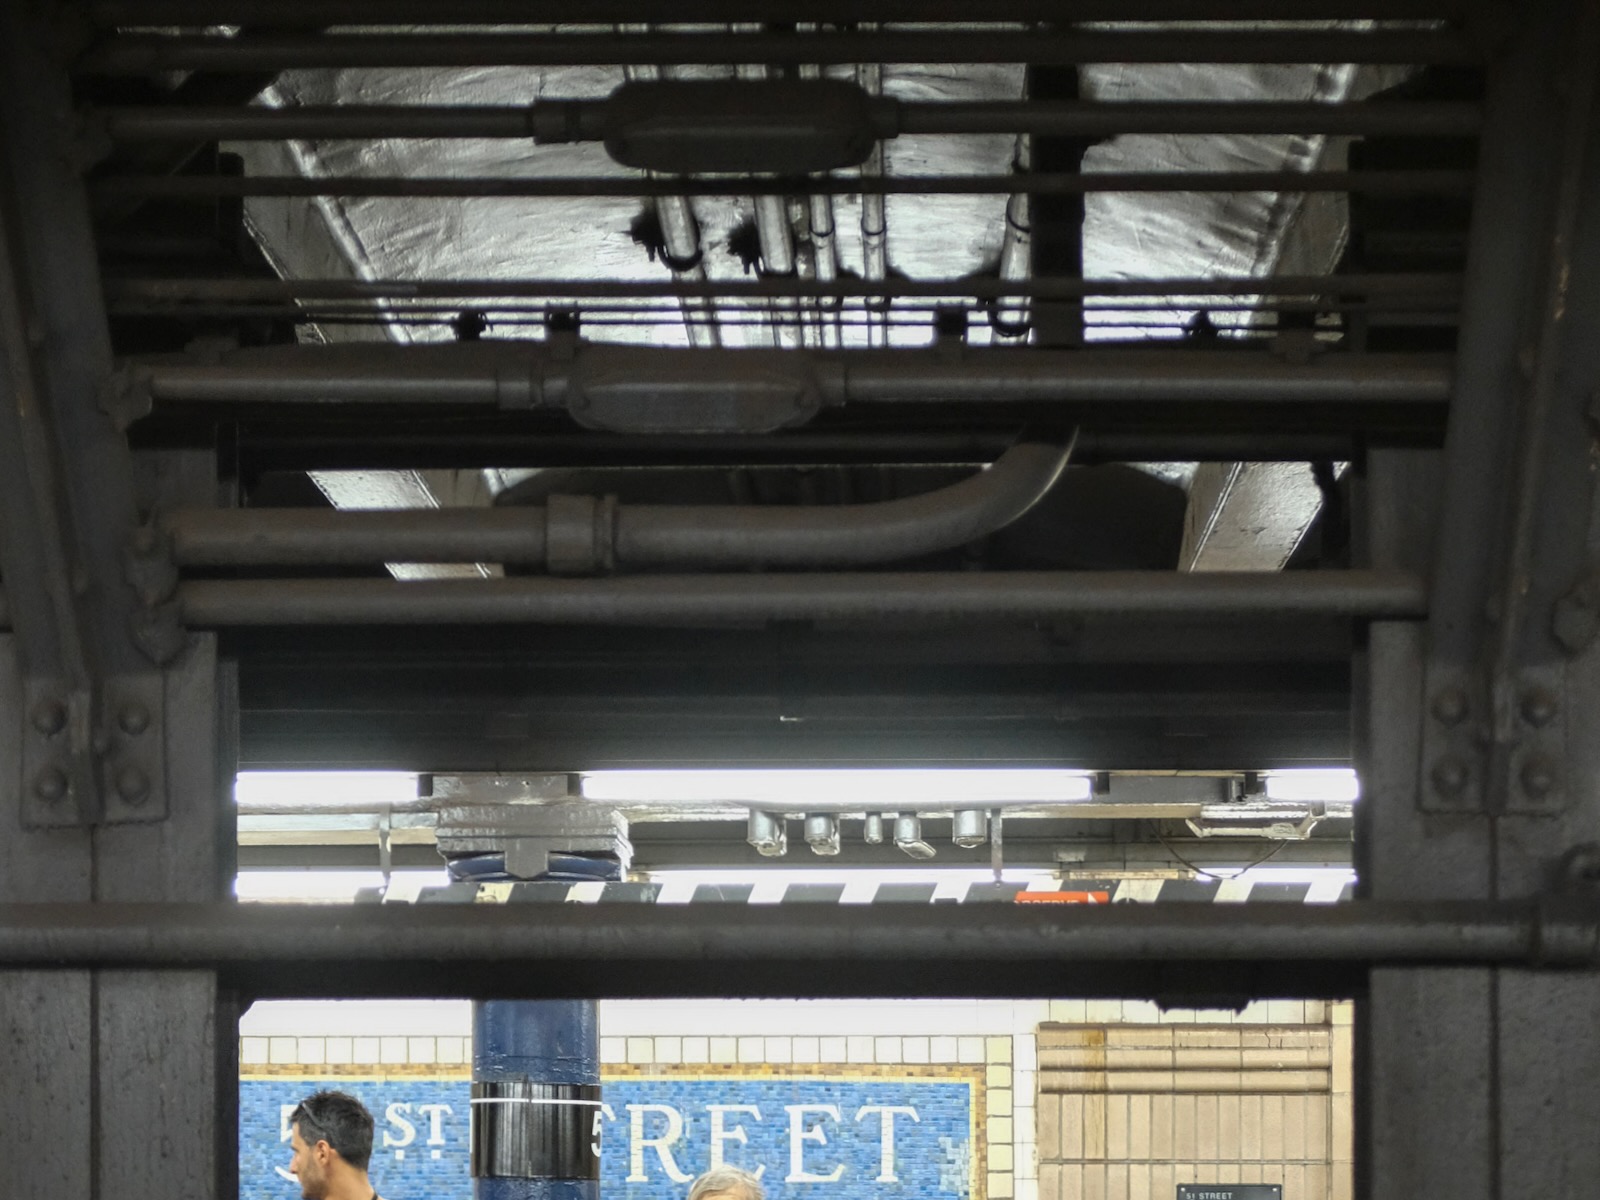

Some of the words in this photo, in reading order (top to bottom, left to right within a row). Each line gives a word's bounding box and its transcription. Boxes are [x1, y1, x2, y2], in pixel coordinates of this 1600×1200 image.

[601, 1104, 921, 1183] REET
[1186, 1192, 1195, 1200] 51
[1199, 1192, 1232, 1200] STREET
